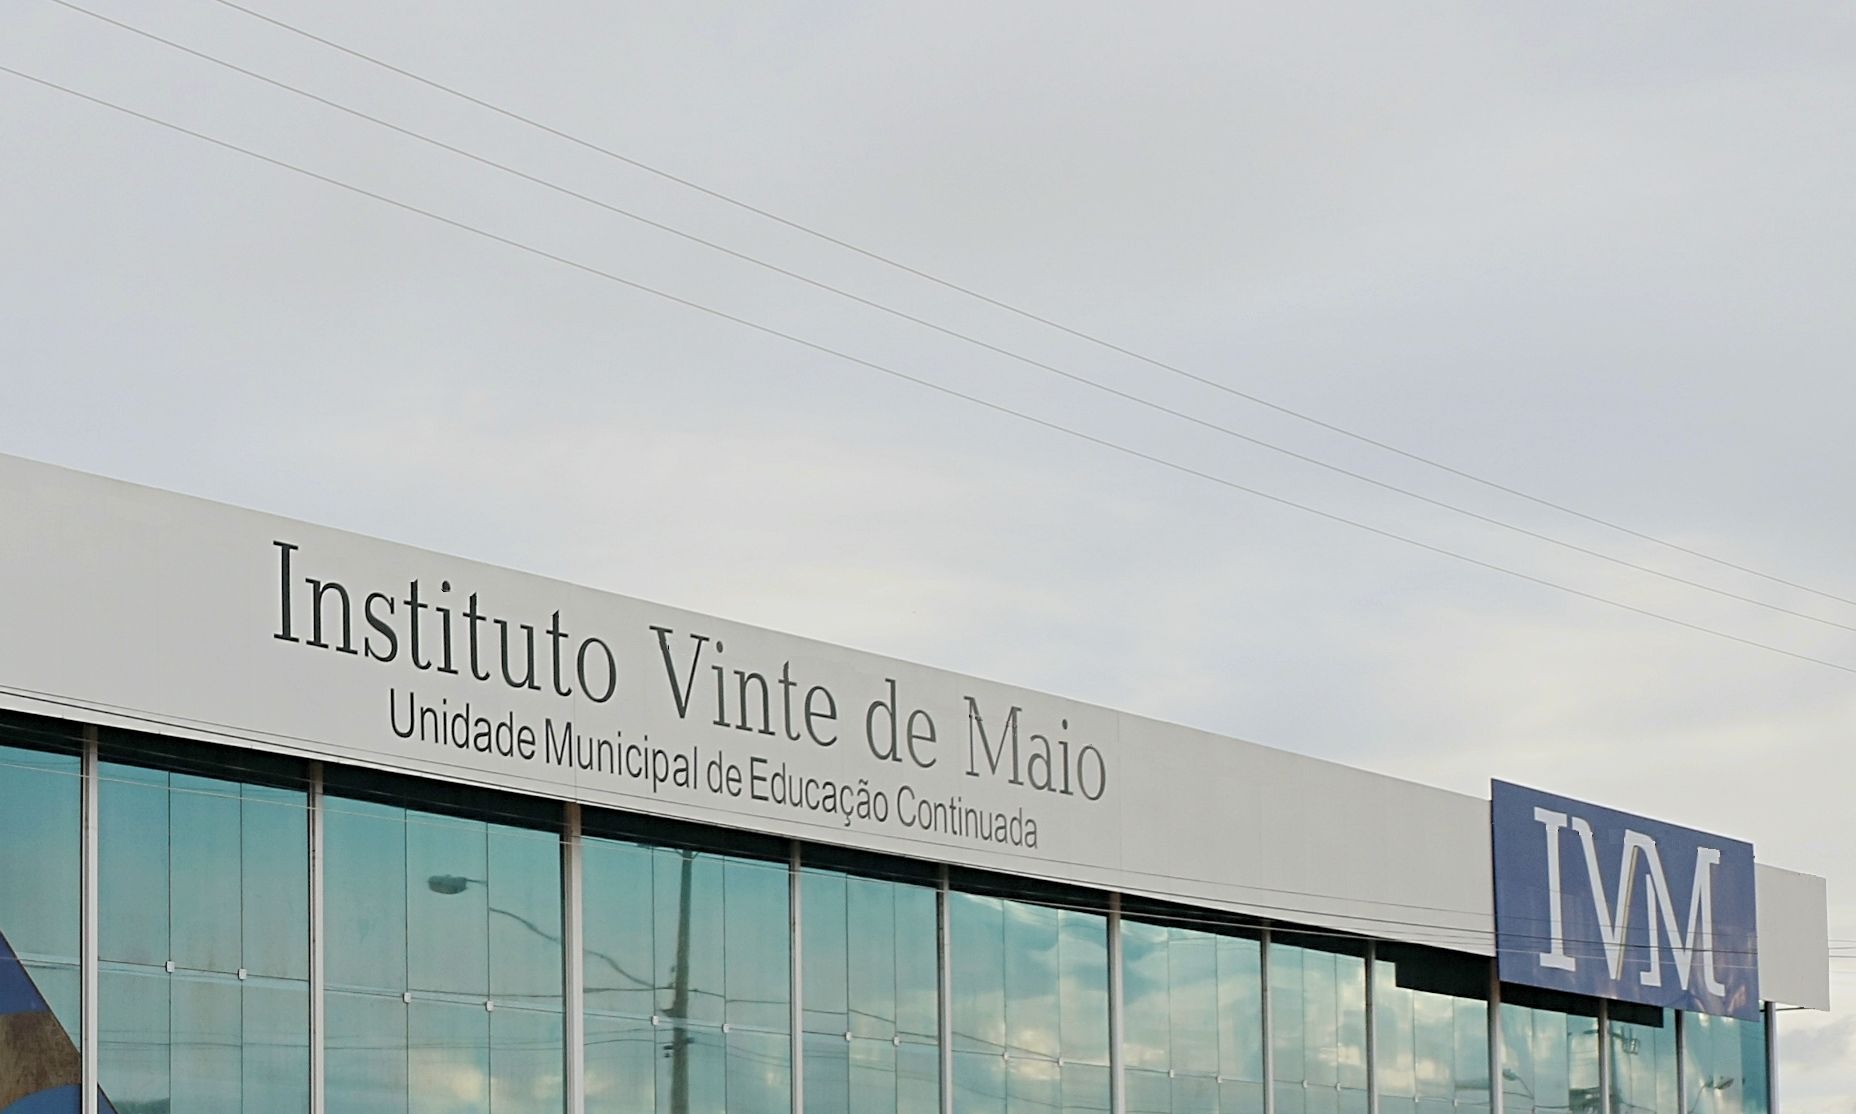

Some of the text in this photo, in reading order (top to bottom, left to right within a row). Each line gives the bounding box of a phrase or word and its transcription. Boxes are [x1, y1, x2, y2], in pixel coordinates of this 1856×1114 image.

[272, 540, 1107, 801] Instituto Vinte de Maio
[389, 687, 1039, 850] Unidade Municipal de Educação Continuada
[1534, 806, 1726, 997] IVM
